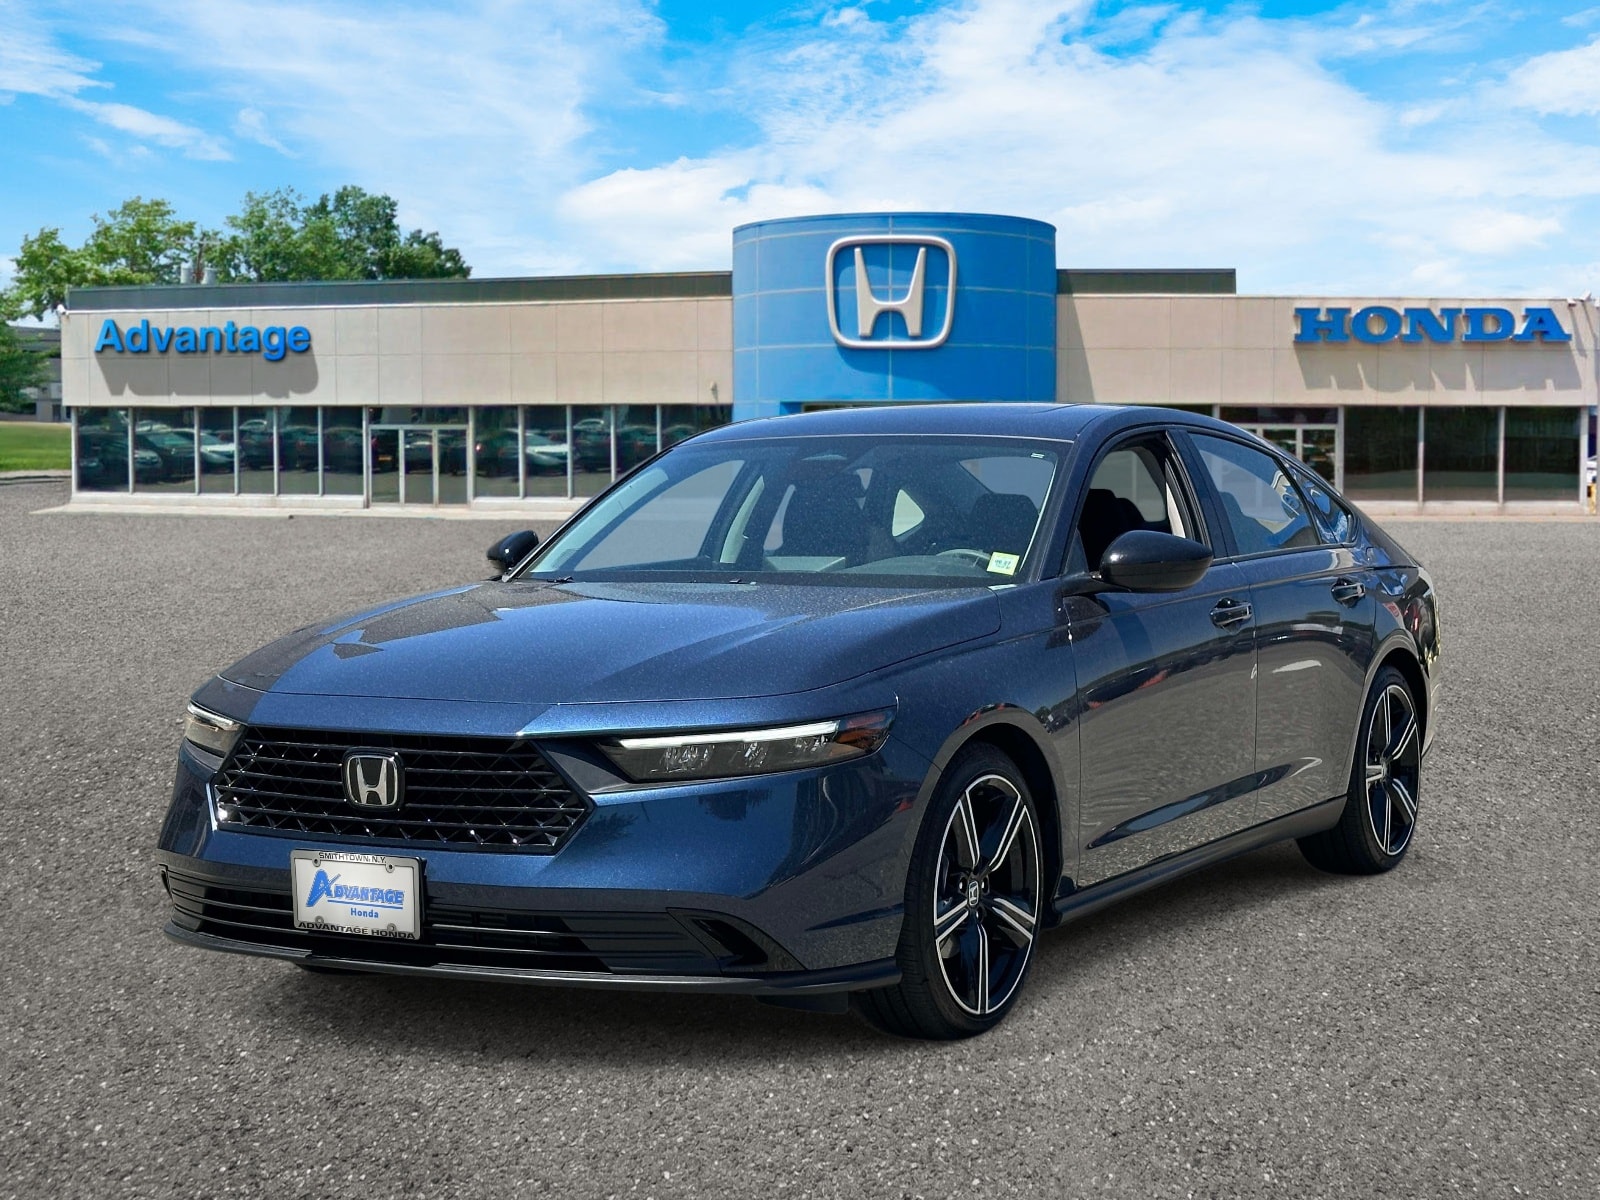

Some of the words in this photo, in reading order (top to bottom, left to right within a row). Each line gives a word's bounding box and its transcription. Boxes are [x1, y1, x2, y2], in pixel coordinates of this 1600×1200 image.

[95, 319, 311, 361] Advantage
[1294, 306, 1572, 343] HONDA
[306, 869, 405, 907] ADVANTAGE
[298, 921, 369, 935] ADVANTAGE
[371, 929, 416, 939] HONDA
[350, 907, 379, 919] Honda
